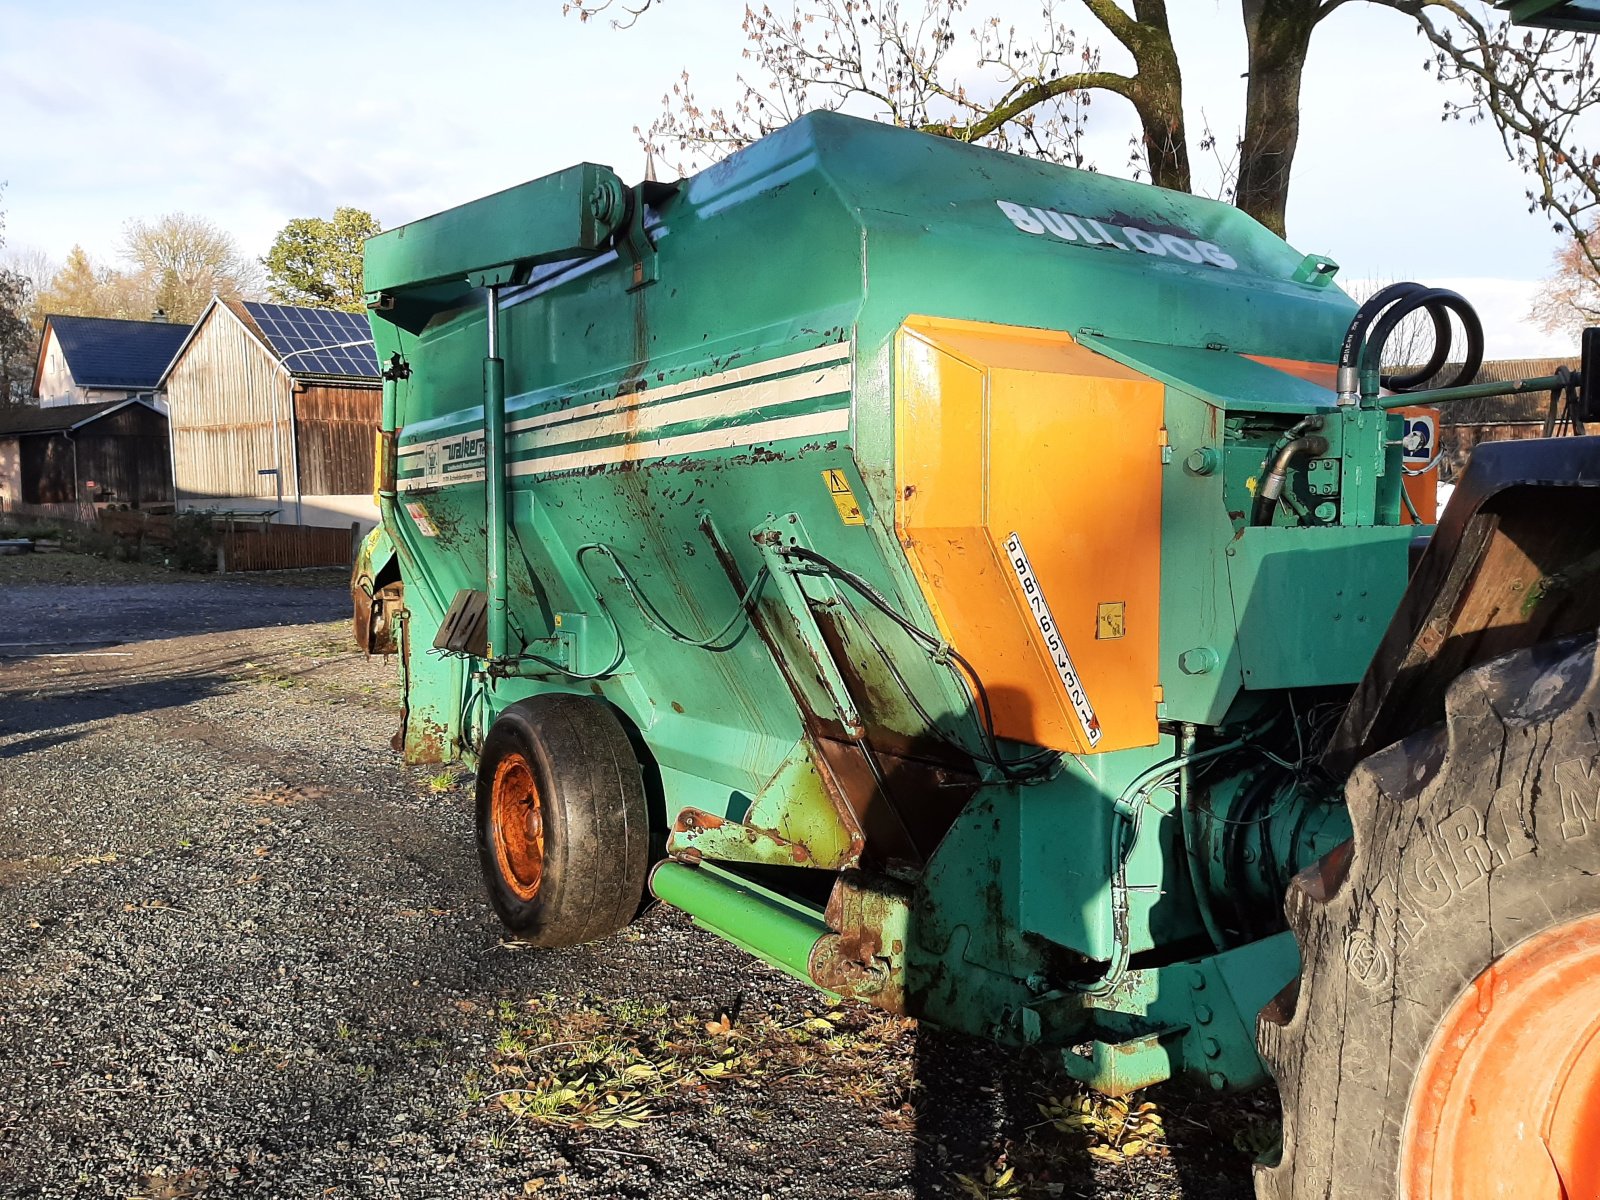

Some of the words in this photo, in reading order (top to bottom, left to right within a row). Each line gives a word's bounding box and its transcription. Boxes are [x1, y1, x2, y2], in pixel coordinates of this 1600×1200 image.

[1015, 557, 1026, 575] 9
[1023, 577, 1035, 594] 8
[1031, 596, 1041, 613] 7
[1040, 616, 1051, 632] 6
[1048, 634, 1058, 651] 5
[1058, 654, 1067, 668] 4
[1064, 672, 1074, 688] 3
[1072, 690, 1083, 706] 2
[1081, 709, 1091, 724] 1
